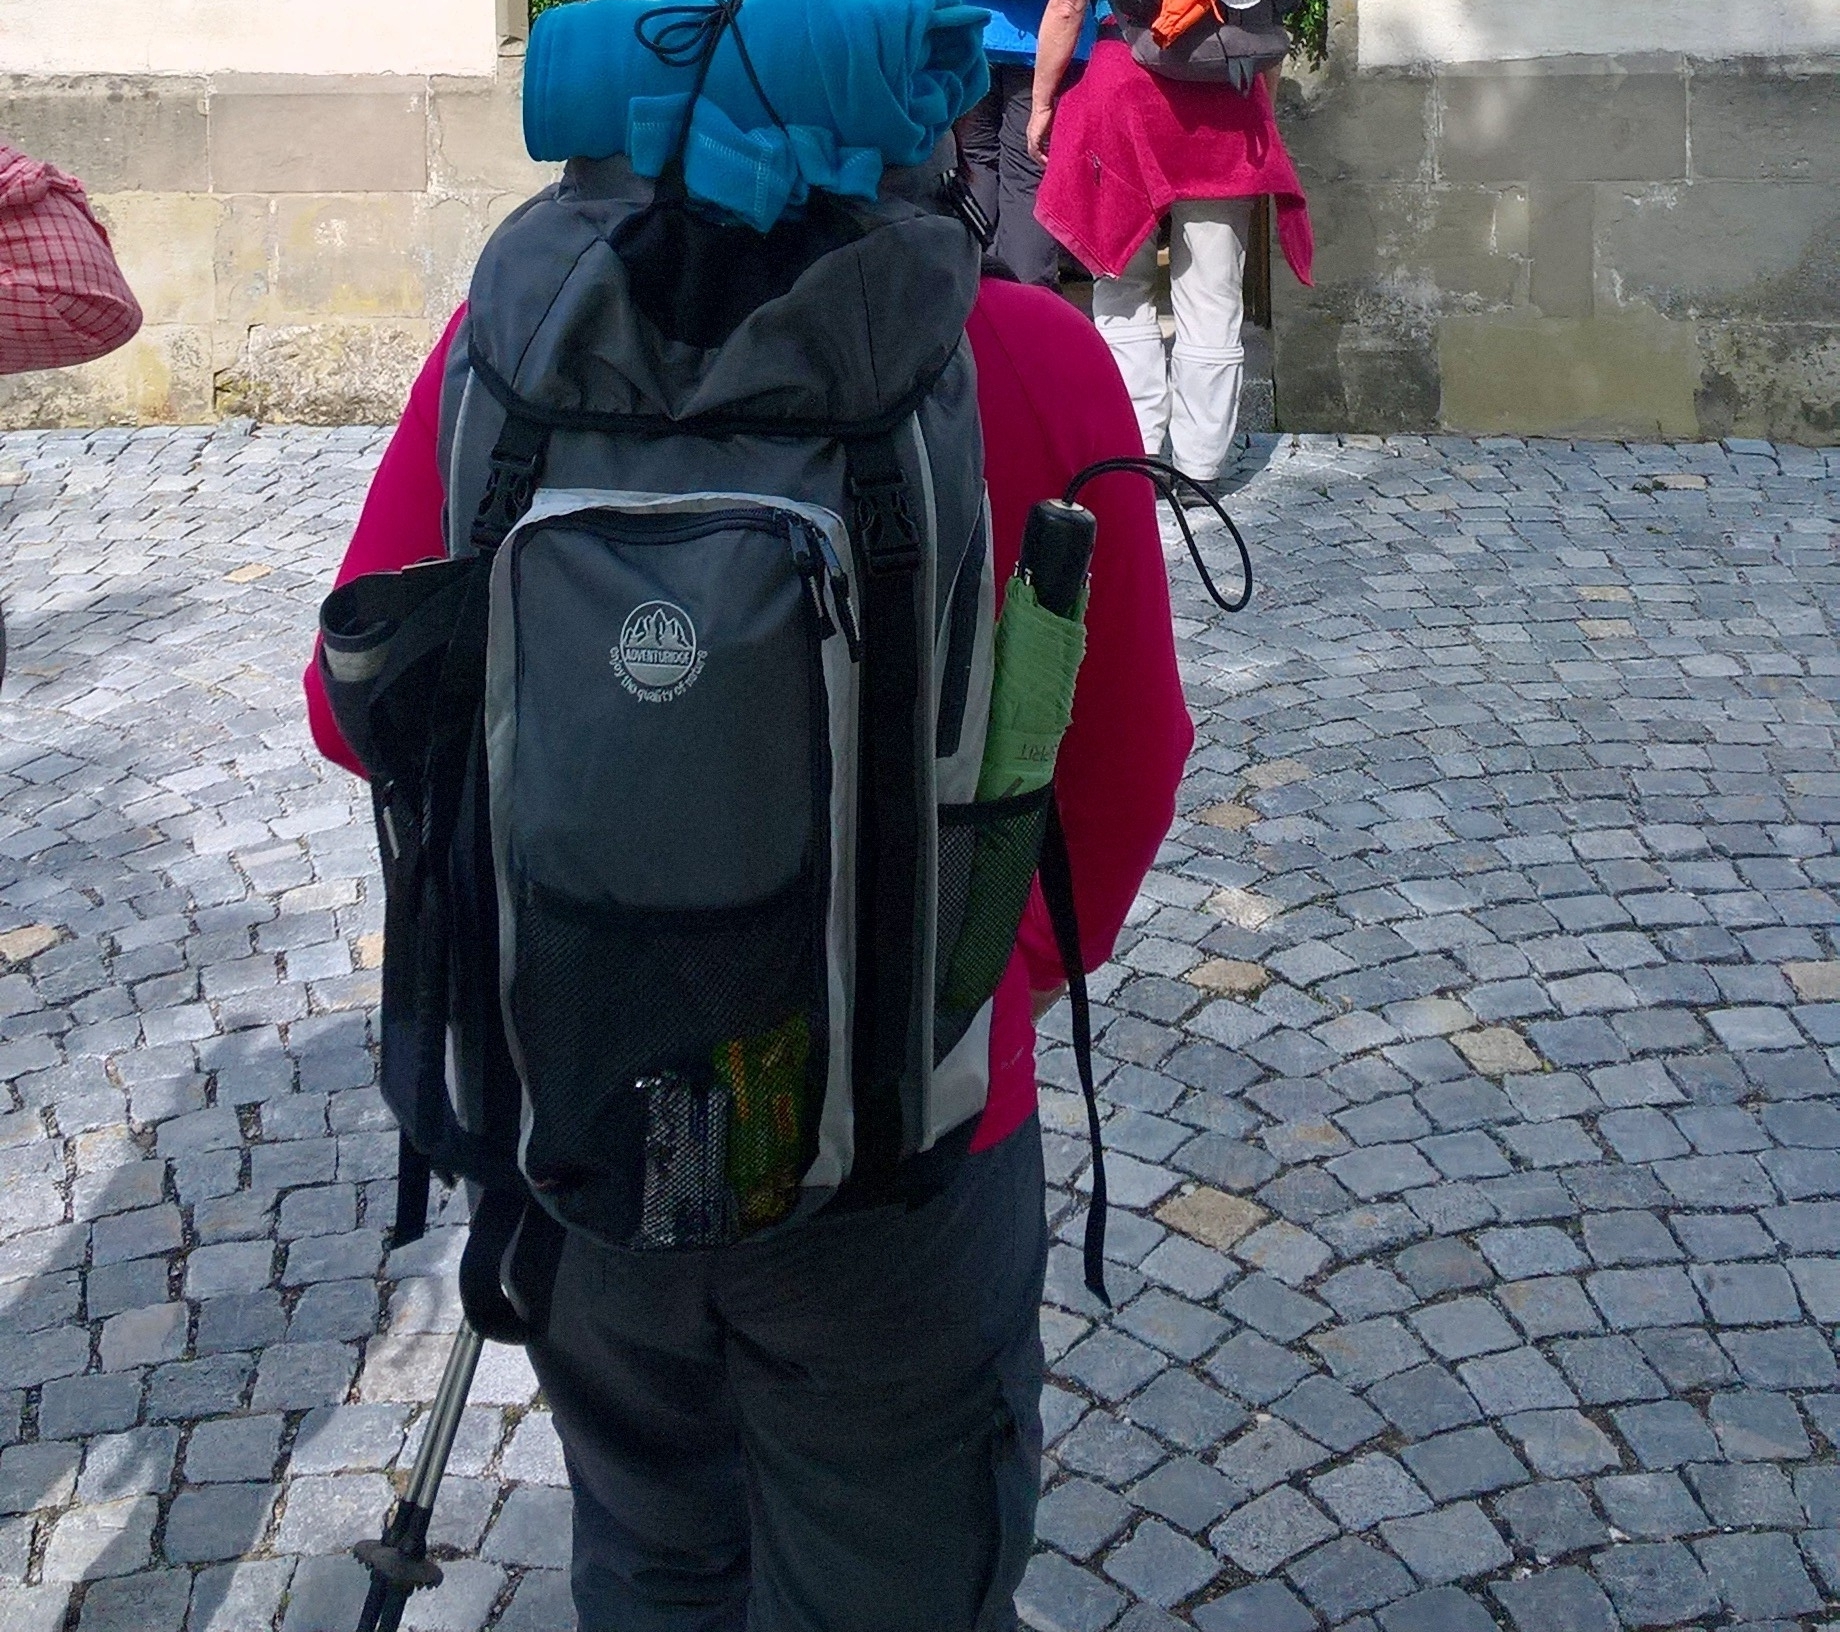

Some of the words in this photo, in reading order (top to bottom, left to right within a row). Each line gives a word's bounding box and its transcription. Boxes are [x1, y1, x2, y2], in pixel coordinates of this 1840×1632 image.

[609, 646, 626, 677] enjoy
[620, 674, 638, 694] the
[636, 688, 674, 703] quality
[674, 680, 687, 696] of
[684, 649, 708, 687] nature
[625, 648, 690, 665] ADVENTURIDGE
